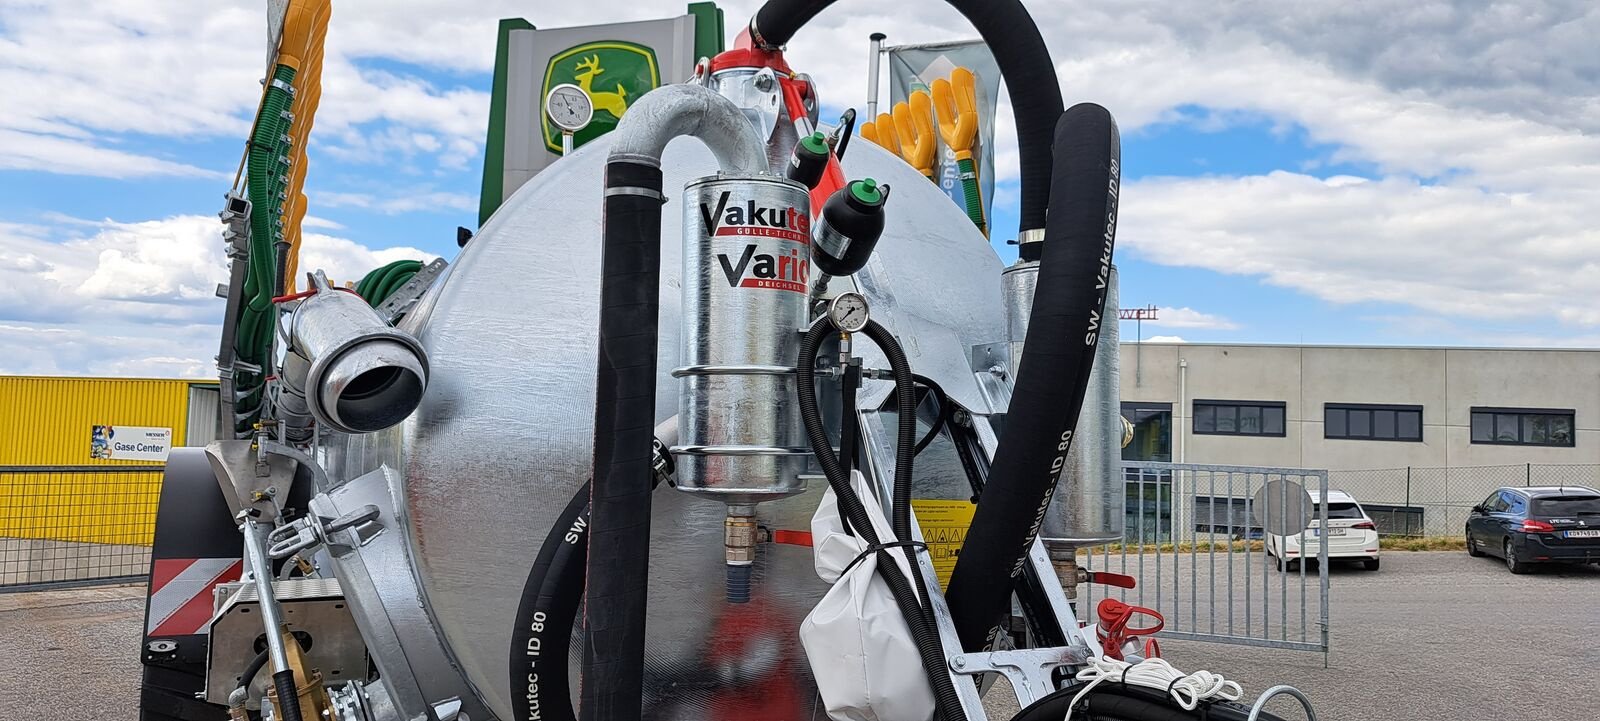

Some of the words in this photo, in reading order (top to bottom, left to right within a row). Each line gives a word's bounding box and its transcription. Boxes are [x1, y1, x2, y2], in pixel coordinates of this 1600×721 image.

[943, 148, 955, 199] ente
[1110, 158, 1120, 180] 80
[1109, 178, 1118, 200] ID
[700, 191, 809, 237] Vakute
[1095, 212, 1115, 290] Vakutec
[758, 280, 801, 291] DEICHSEL
[1085, 309, 1100, 346] SW
[114, 442, 136, 452] Gase
[136, 443, 164, 453] Center
[1010, 556, 1026, 578] SW
[1023, 487, 1054, 546] Vakutec
[1050, 456, 1064, 474] ID
[1057, 430, 1072, 451] 80
[564, 516, 587, 545] SW
[531, 611, 547, 633] 80
[986, 625, 999, 642] 80
[526, 637, 541, 656] ID
[526, 672, 541, 721] kutec
